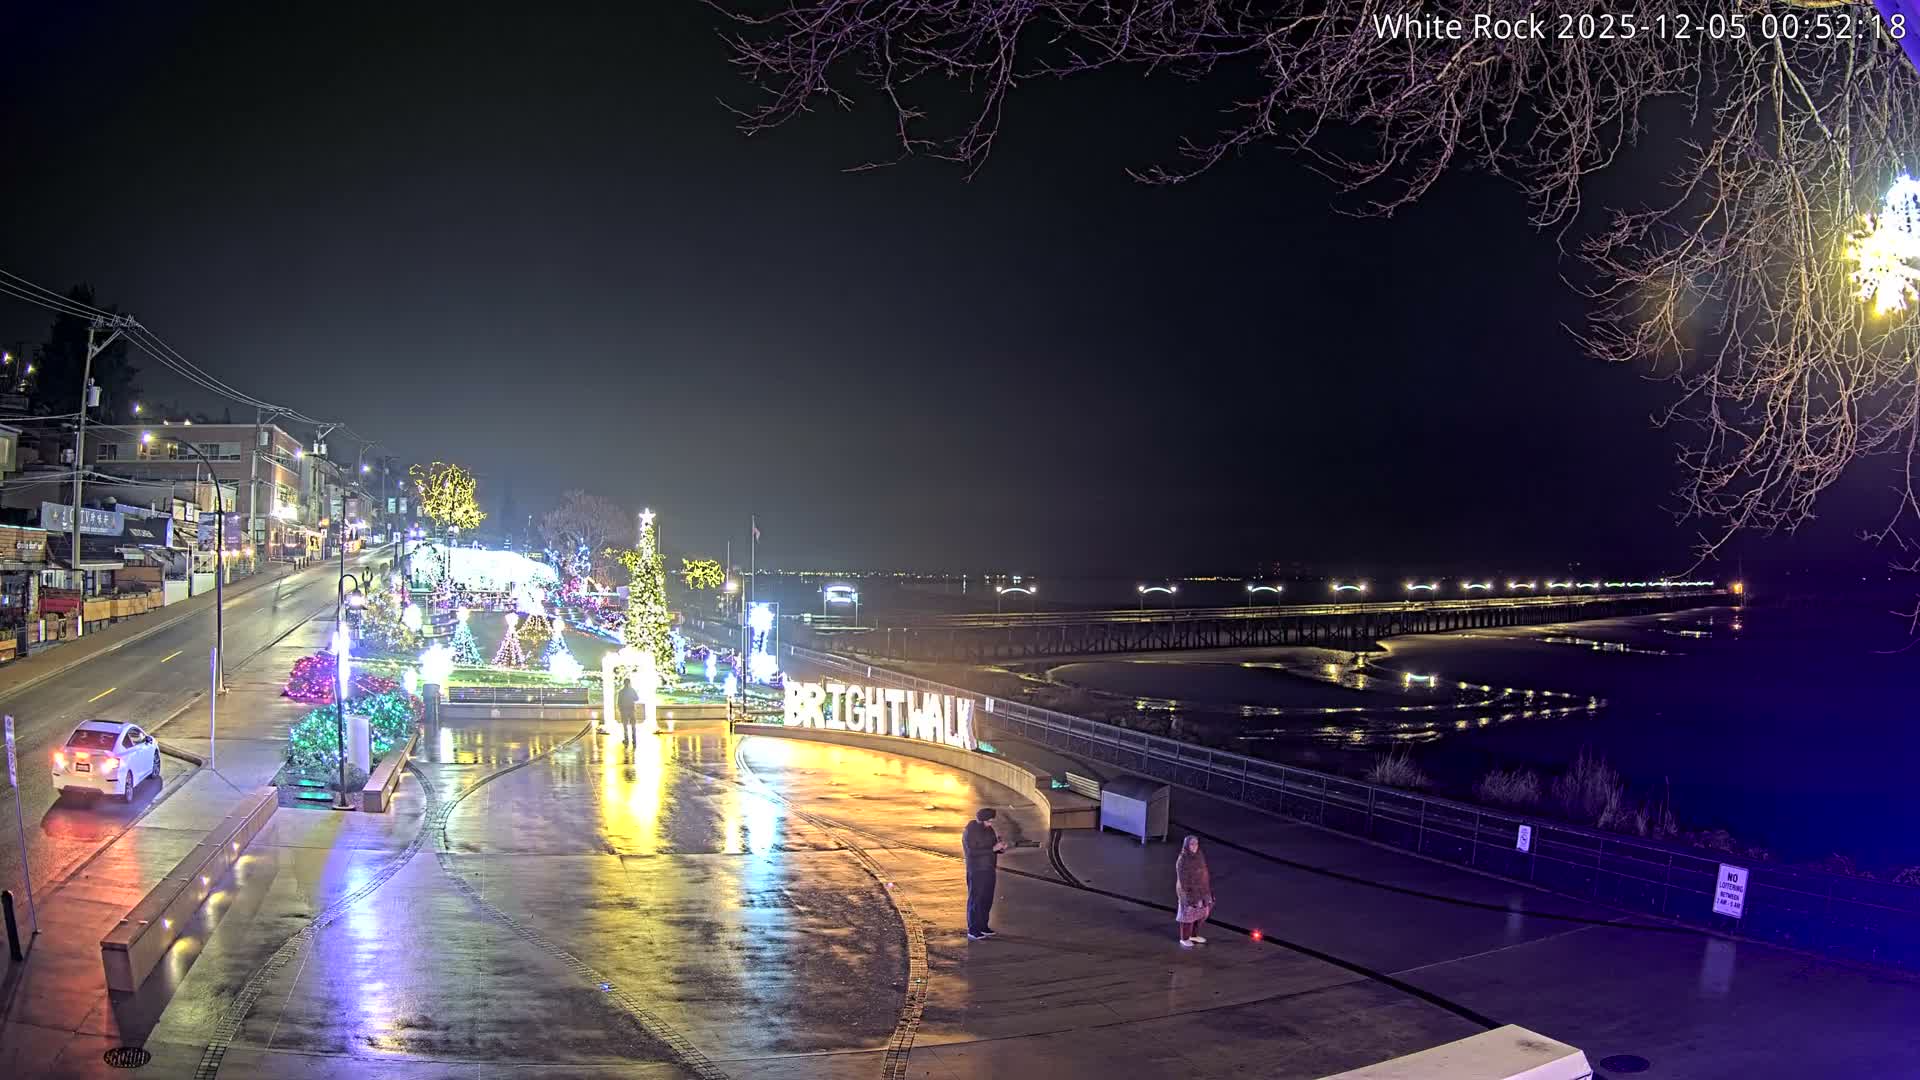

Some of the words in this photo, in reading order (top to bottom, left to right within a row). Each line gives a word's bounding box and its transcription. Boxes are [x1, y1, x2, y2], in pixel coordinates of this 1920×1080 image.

[783, 680, 977, 750] BRIGHTWALK
[1727, 872, 1738, 883] NO
[1720, 882, 1744, 892] LOITERING
